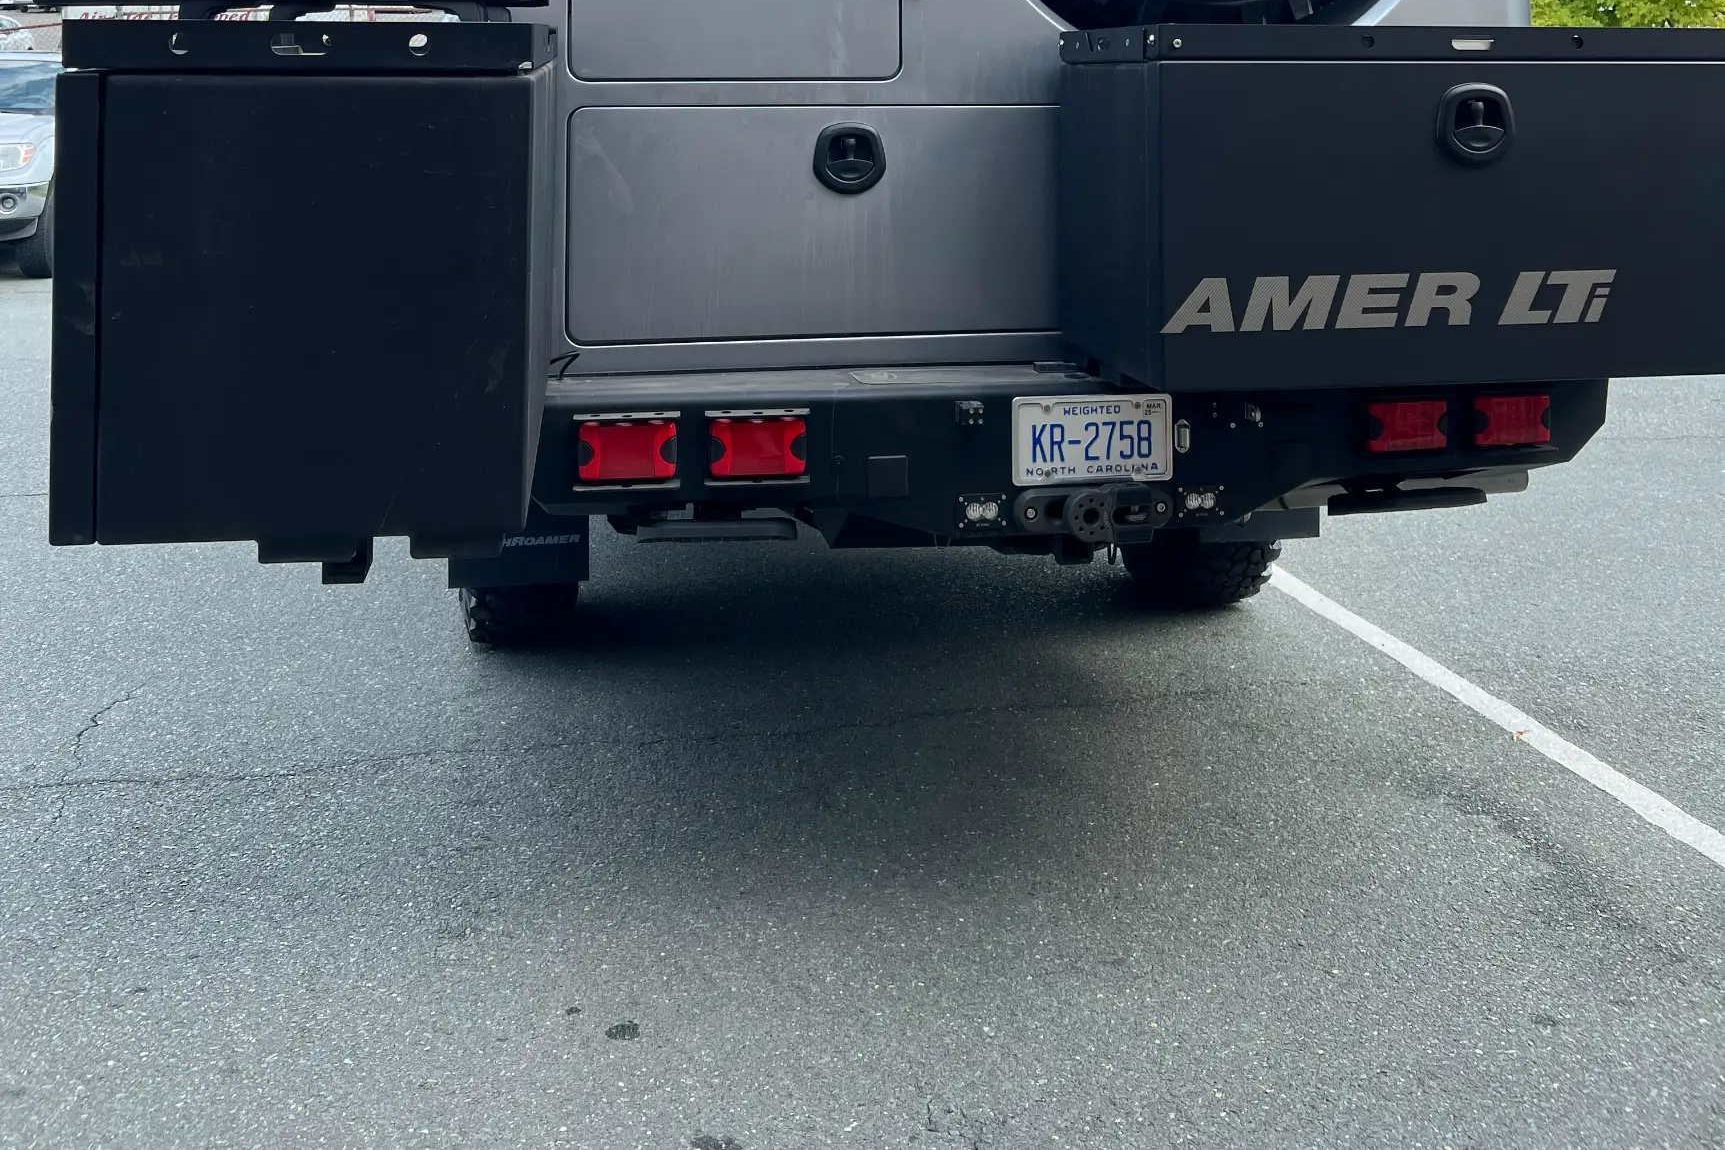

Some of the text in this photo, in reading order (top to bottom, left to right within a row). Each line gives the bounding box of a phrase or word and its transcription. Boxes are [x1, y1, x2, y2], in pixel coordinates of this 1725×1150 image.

[1159, 271, 1481, 334] AMER
[1062, 405, 1121, 416] WEIGHTED
[1146, 402, 1162, 410] MAR
[1031, 419, 1153, 464] KR-2758
[1025, 462, 1160, 477] NORTH CAROLINA
